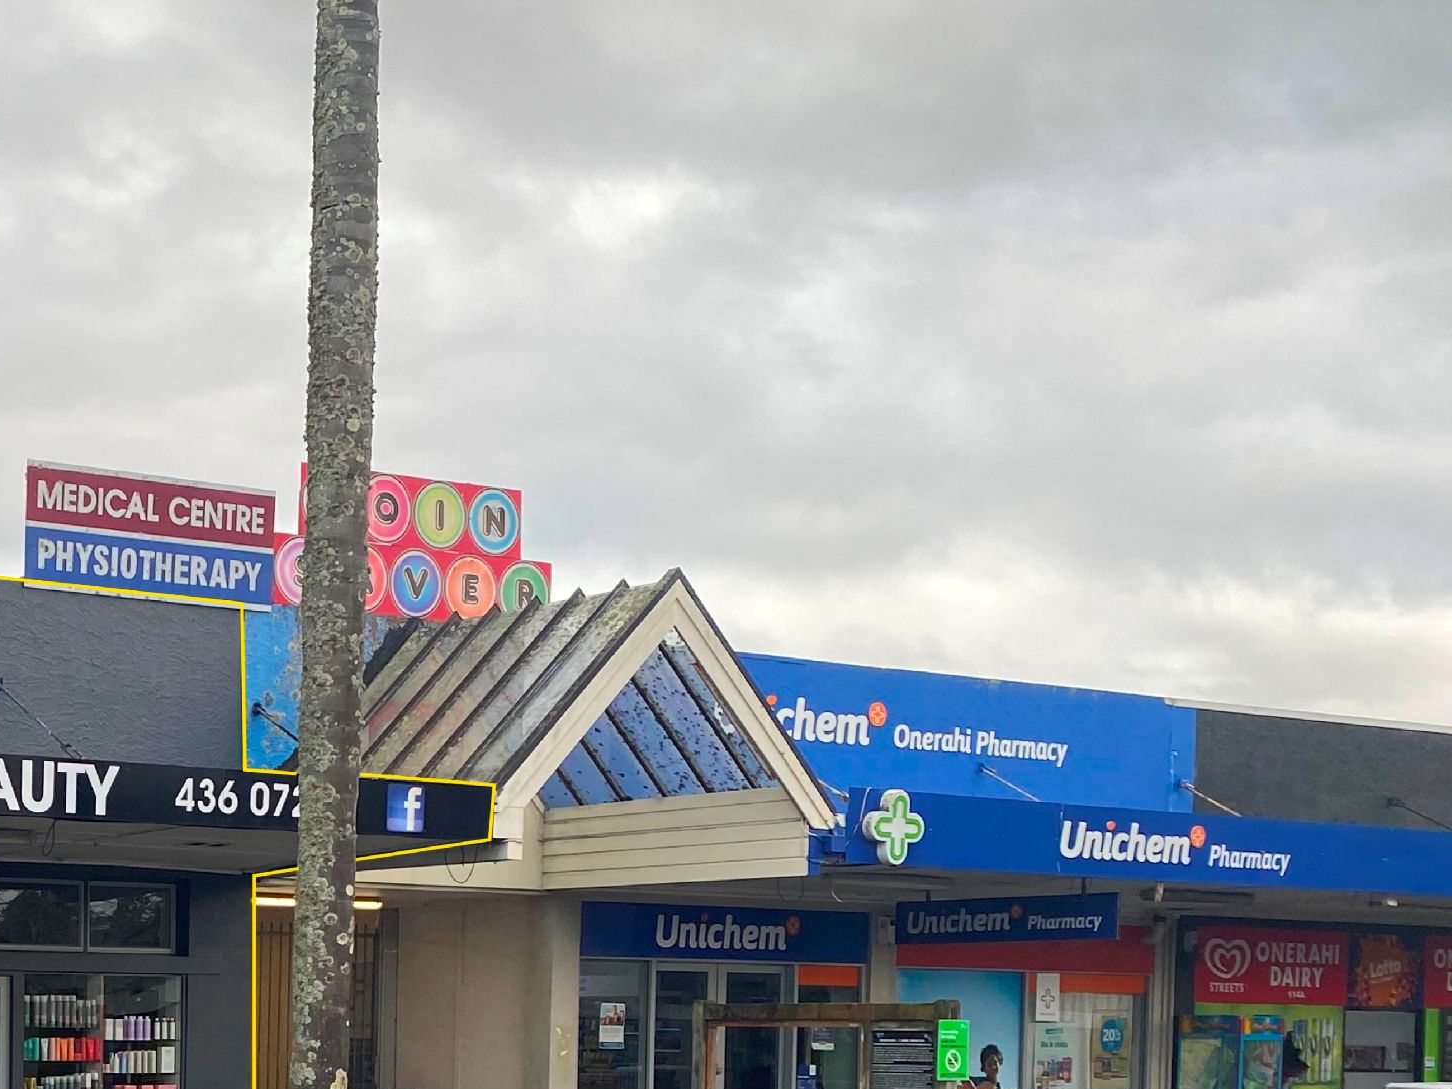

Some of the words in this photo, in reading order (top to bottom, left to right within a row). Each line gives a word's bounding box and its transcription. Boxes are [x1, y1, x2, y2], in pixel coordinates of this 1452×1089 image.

[36, 479, 159, 522] MEDICAL
[168, 496, 265, 535] CENTRE
[374, 492, 506, 538] OIN
[37, 537, 262, 591] PHYSIOTHERAPY
[767, 695, 870, 746] chem
[893, 723, 971, 754] Onerahi
[975, 730, 1069, 768] Pharmacy
[175, 777, 239, 816] 436
[1059, 819, 1191, 866] Unichem
[1207, 843, 1292, 877] Pharmacy
[655, 912, 788, 952] Unichem
[906, 907, 1011, 935] Unichem
[1027, 913, 1103, 933] Pharmacy
[1255, 941, 1340, 965] ONERAHI
[1370, 959, 1402, 978] Lotto
[1209, 982, 1245, 993] STREETS
[1269, 966, 1324, 988] DAIRY
